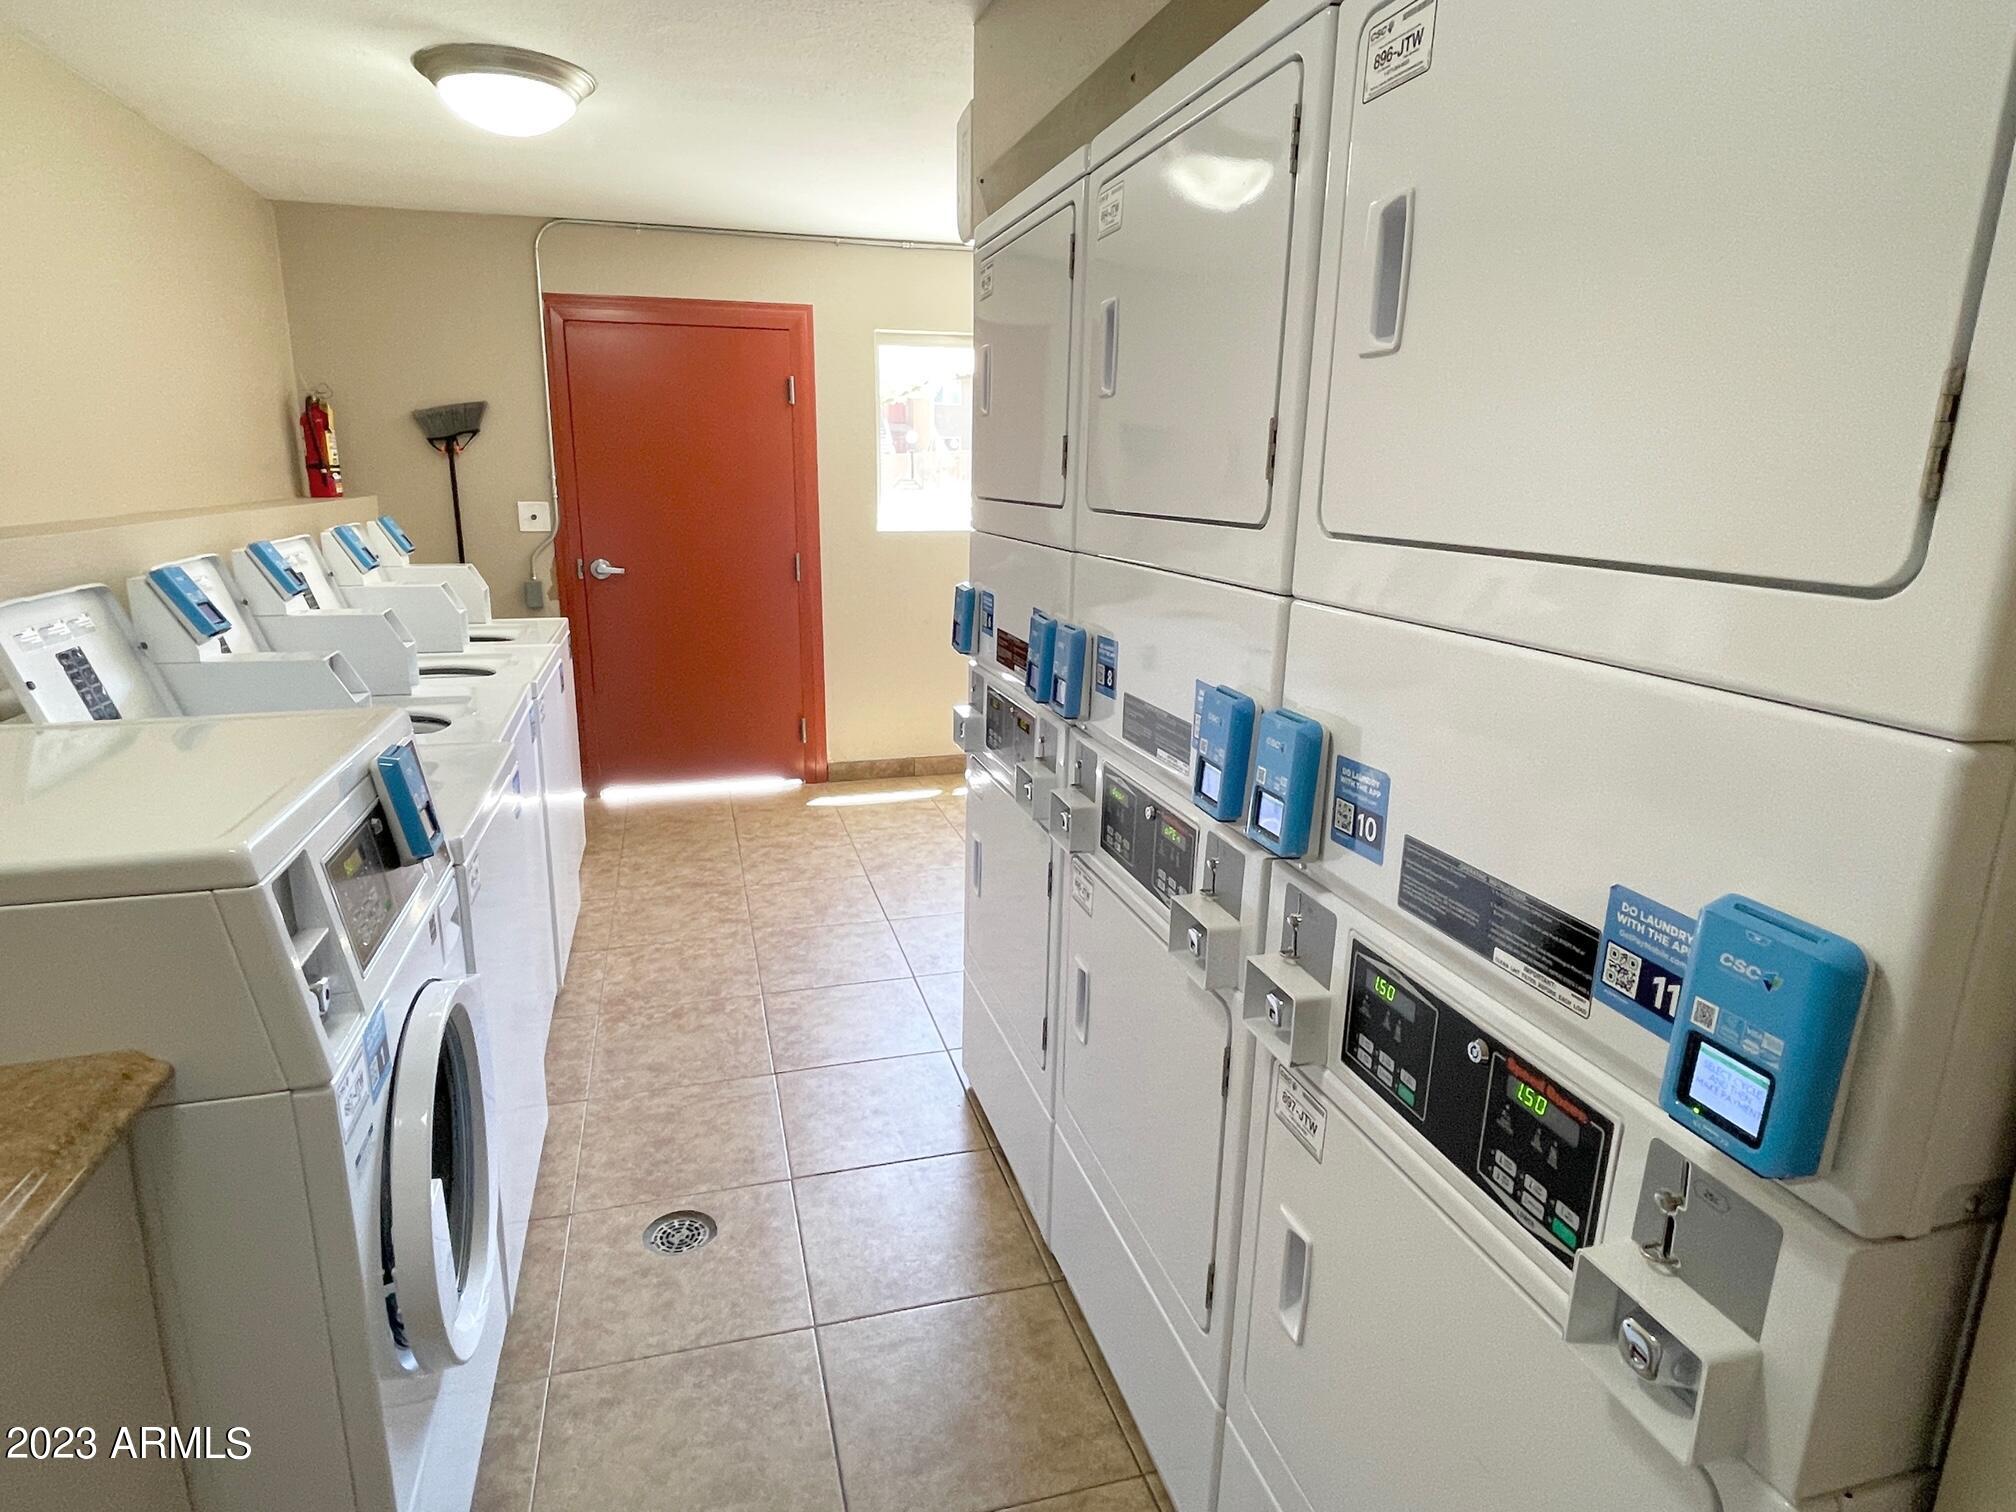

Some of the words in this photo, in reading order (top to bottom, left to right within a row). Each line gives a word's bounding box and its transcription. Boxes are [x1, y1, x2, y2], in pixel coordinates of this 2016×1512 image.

[1373, 26, 1425, 70] 896-JTW
[1107, 670, 1113, 687] 8
[1357, 813, 1377, 842] 10
[1617, 911, 1645, 935] WITH
[1648, 928, 1670, 946] THE
[1671, 941, 1691, 956] AP
[1621, 901, 1638, 917] DO
[1640, 911, 1694, 945] LAUNDRY
[1720, 952, 1762, 980] CSC
[1652, 976, 1681, 1018] 11
